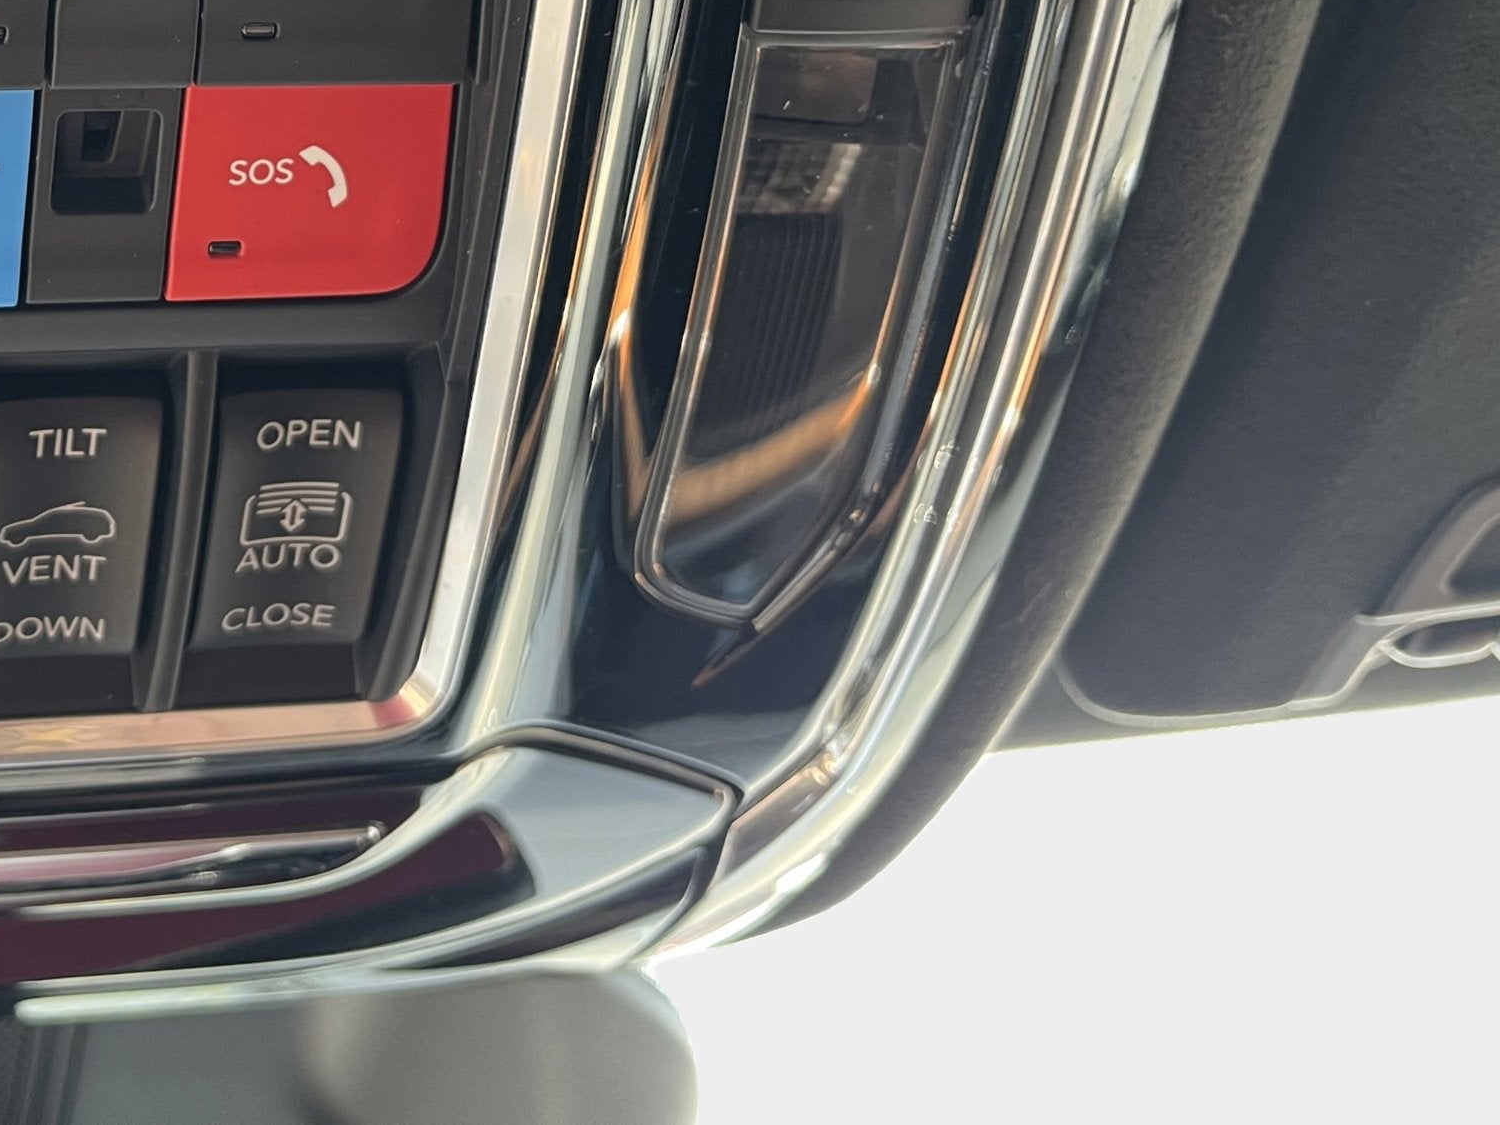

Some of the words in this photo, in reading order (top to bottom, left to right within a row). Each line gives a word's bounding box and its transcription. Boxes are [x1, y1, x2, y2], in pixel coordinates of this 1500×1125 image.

[228, 158, 294, 187] SOS
[29, 428, 108, 459] TILT
[256, 419, 362, 451] OPEN
[1, 555, 107, 584] VENT
[235, 544, 340, 573] AUTO
[221, 603, 336, 631] CLOSE
